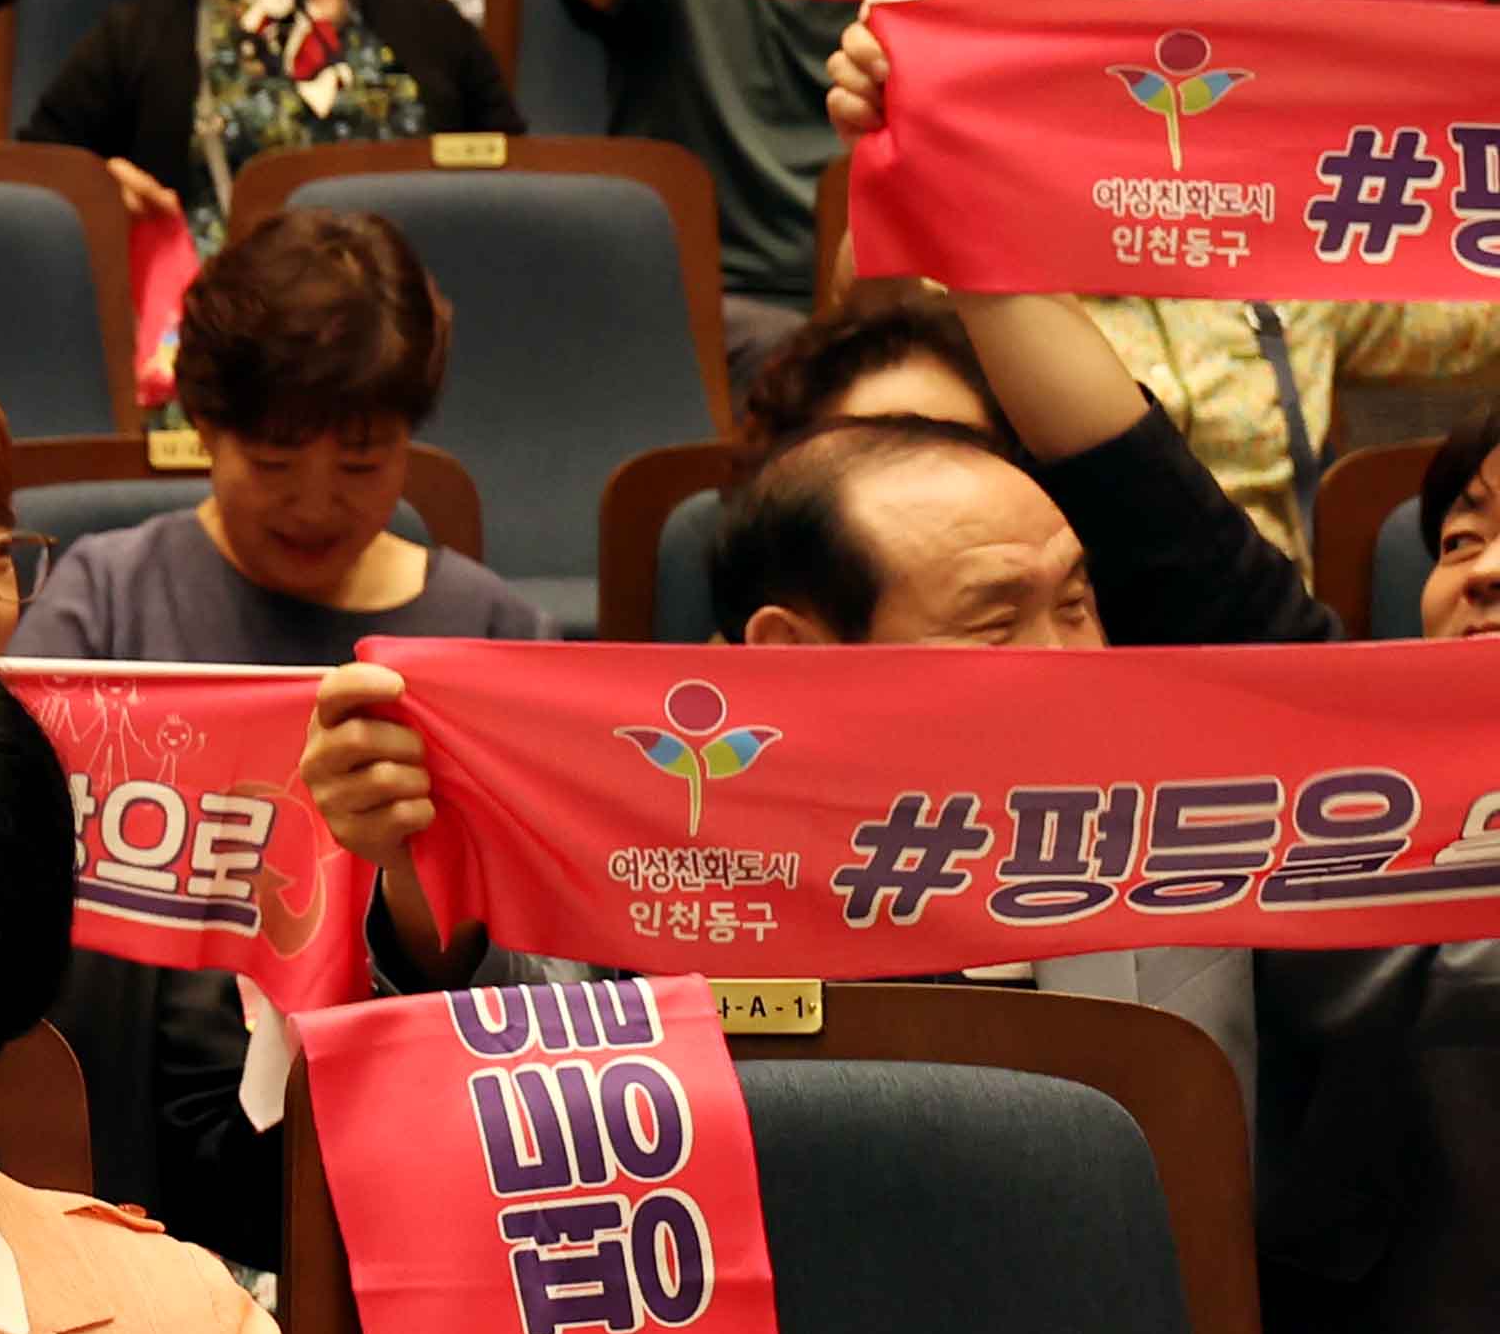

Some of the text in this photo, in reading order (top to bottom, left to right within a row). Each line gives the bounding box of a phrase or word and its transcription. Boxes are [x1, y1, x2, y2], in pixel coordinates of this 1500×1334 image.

[1110, 224, 1250, 268] 인천동구
[606, 847, 799, 893] 여성친화도시
[830, 767, 1421, 929] #평등을
[629, 898, 779, 944] 인천동구
